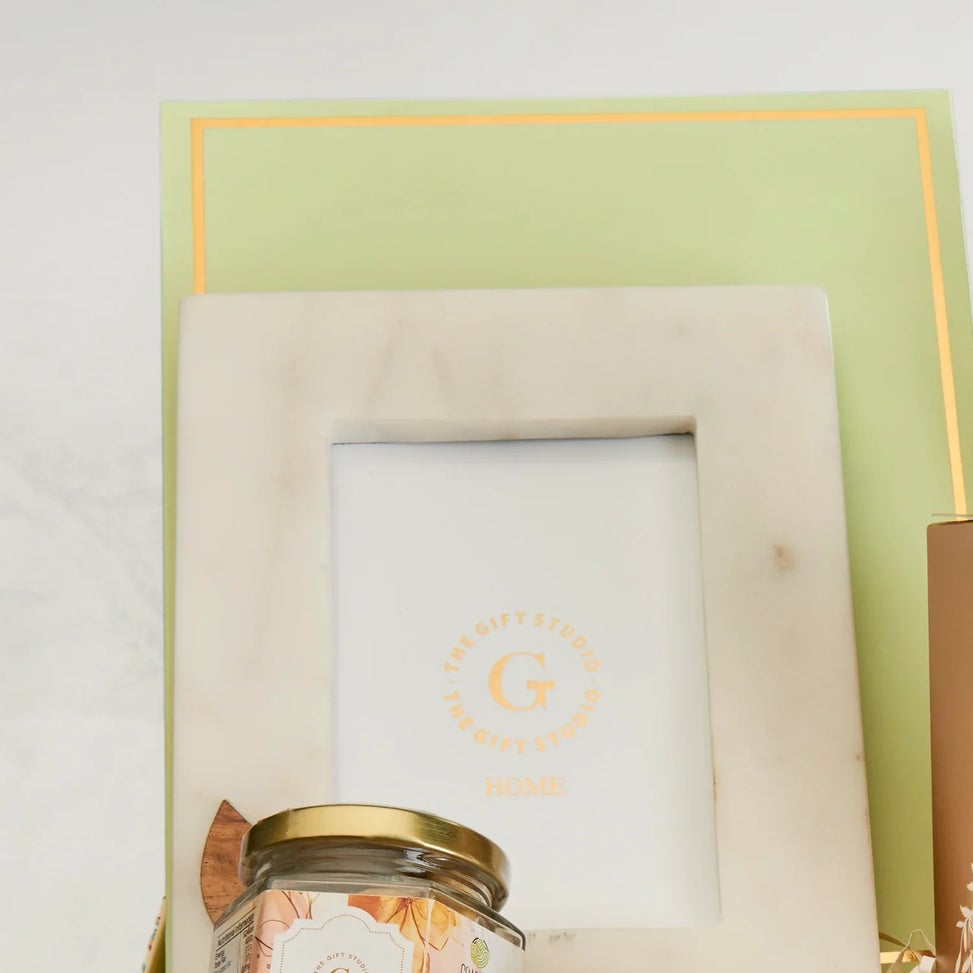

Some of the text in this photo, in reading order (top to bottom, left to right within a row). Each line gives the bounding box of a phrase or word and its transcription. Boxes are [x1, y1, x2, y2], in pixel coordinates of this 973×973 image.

[443, 610, 600, 672] THE GIFT STUDIO
[487, 651, 555, 712] G
[443, 688, 600, 755] THE GIFT STUDIO
[485, 776, 566, 797] HOME
[326, 952, 345, 961] GIFT
